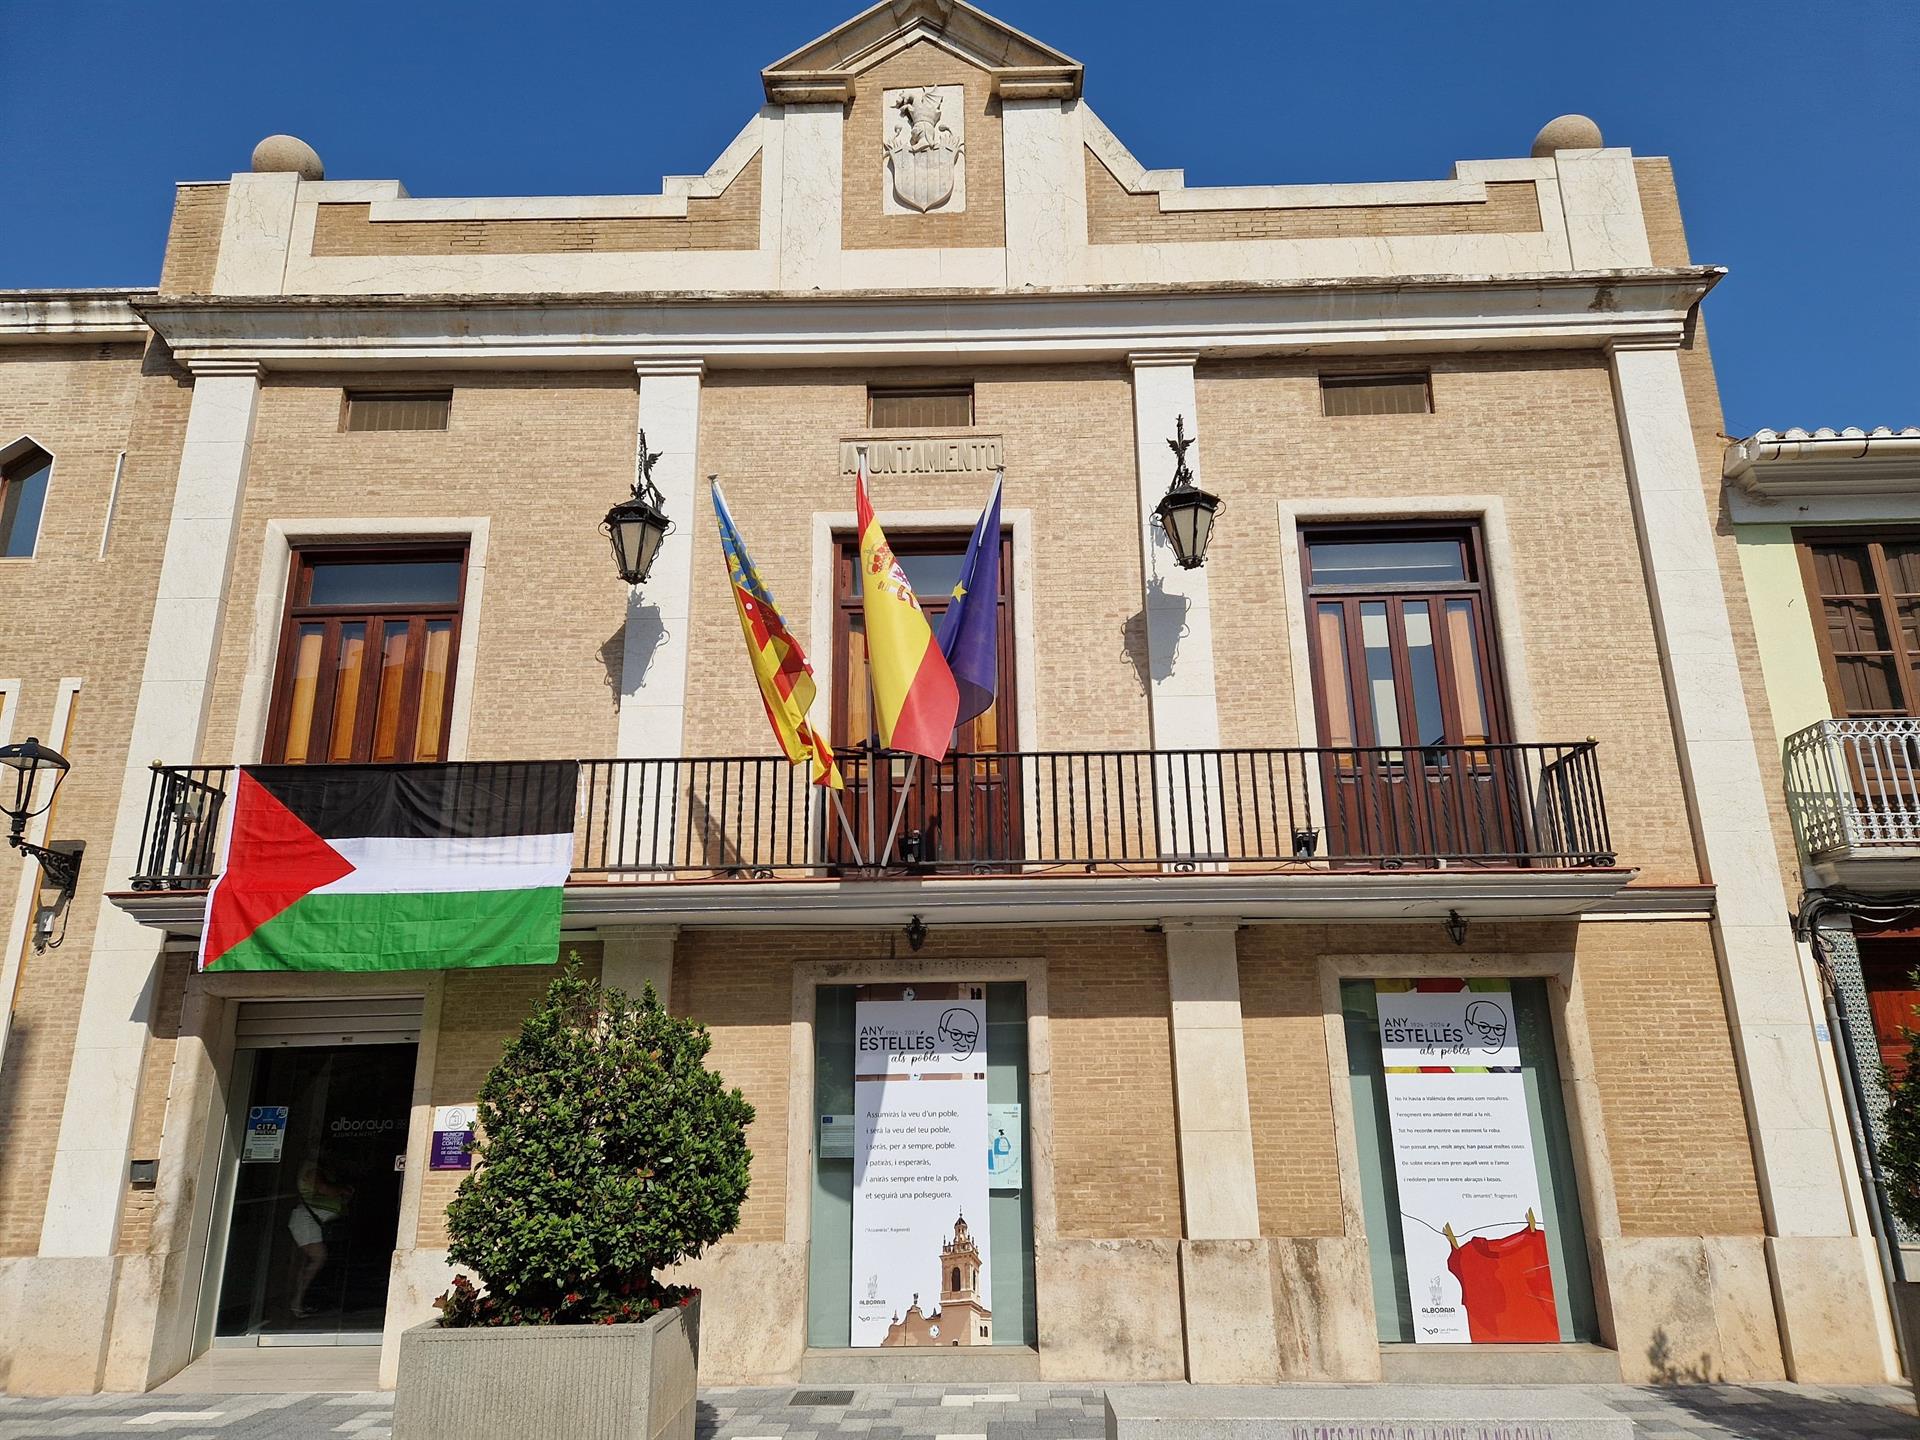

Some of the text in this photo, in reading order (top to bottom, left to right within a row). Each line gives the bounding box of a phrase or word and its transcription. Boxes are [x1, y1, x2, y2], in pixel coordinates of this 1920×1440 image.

[843, 442, 1000, 474] AUNTAMIENTO
[1384, 1018, 1408, 1028] ANY
[860, 1026, 884, 1036] ANY
[1385, 1024, 1464, 1042] ESTELLÉS
[860, 1031, 935, 1050] ESTELLÉS
[1420, 1044, 1471, 1059] als pobles
[891, 1051, 940, 1066] als pobles
[938, 1110, 960, 1118] poble,
[330, 1116, 394, 1133] alboraya
[930, 1126, 952, 1134] poble,
[943, 1174, 960, 1182] pols,
[874, 1191, 898, 1200] seguirà
[913, 1191, 952, 1200] polseguera.
